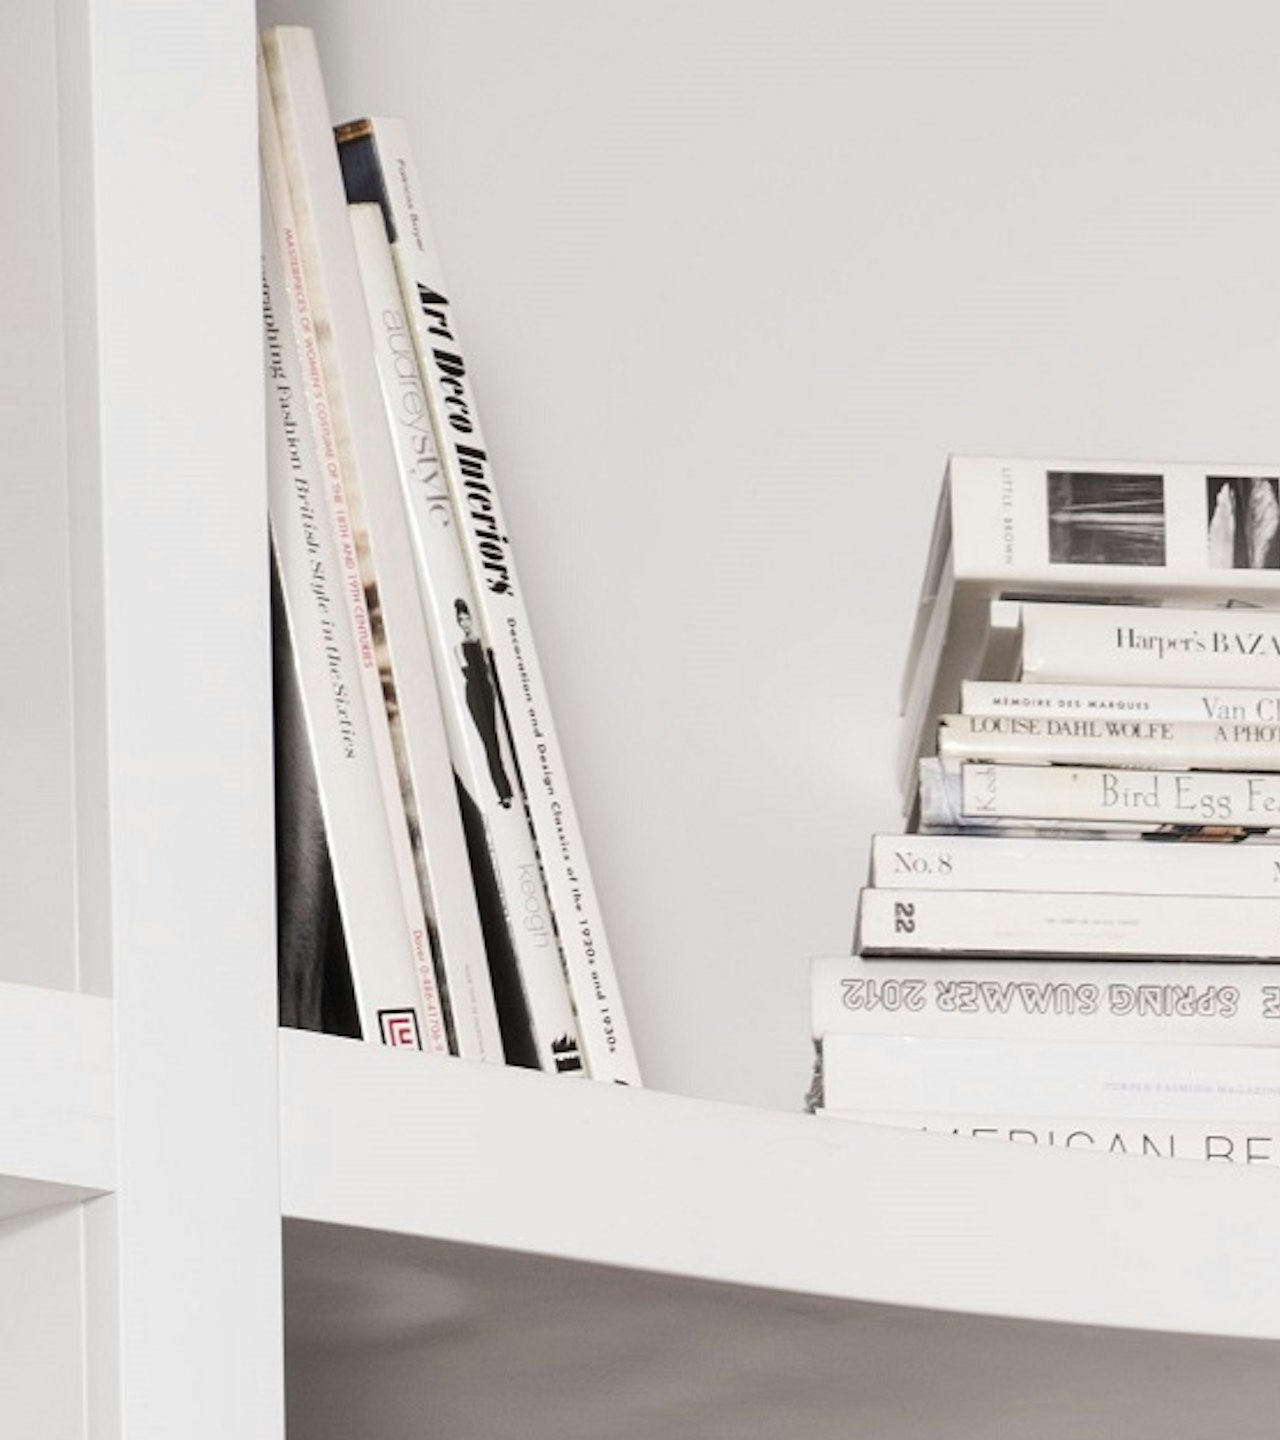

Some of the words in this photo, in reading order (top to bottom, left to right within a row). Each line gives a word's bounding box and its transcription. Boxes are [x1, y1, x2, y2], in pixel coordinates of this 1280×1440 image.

[416, 281, 454, 342] Art
[432, 348, 474, 435] Deco
[383, 309, 451, 528] audreystyle
[456, 444, 515, 597] Interiors
[1116, 628, 1206, 659] Harper's
[1201, 696, 1248, 722] Van
[1101, 773, 1160, 810] Bird
[1175, 776, 1232, 818] Egg
[894, 852, 932, 874] No.
[937, 853, 953, 875] 8
[894, 902, 915, 933] 22
